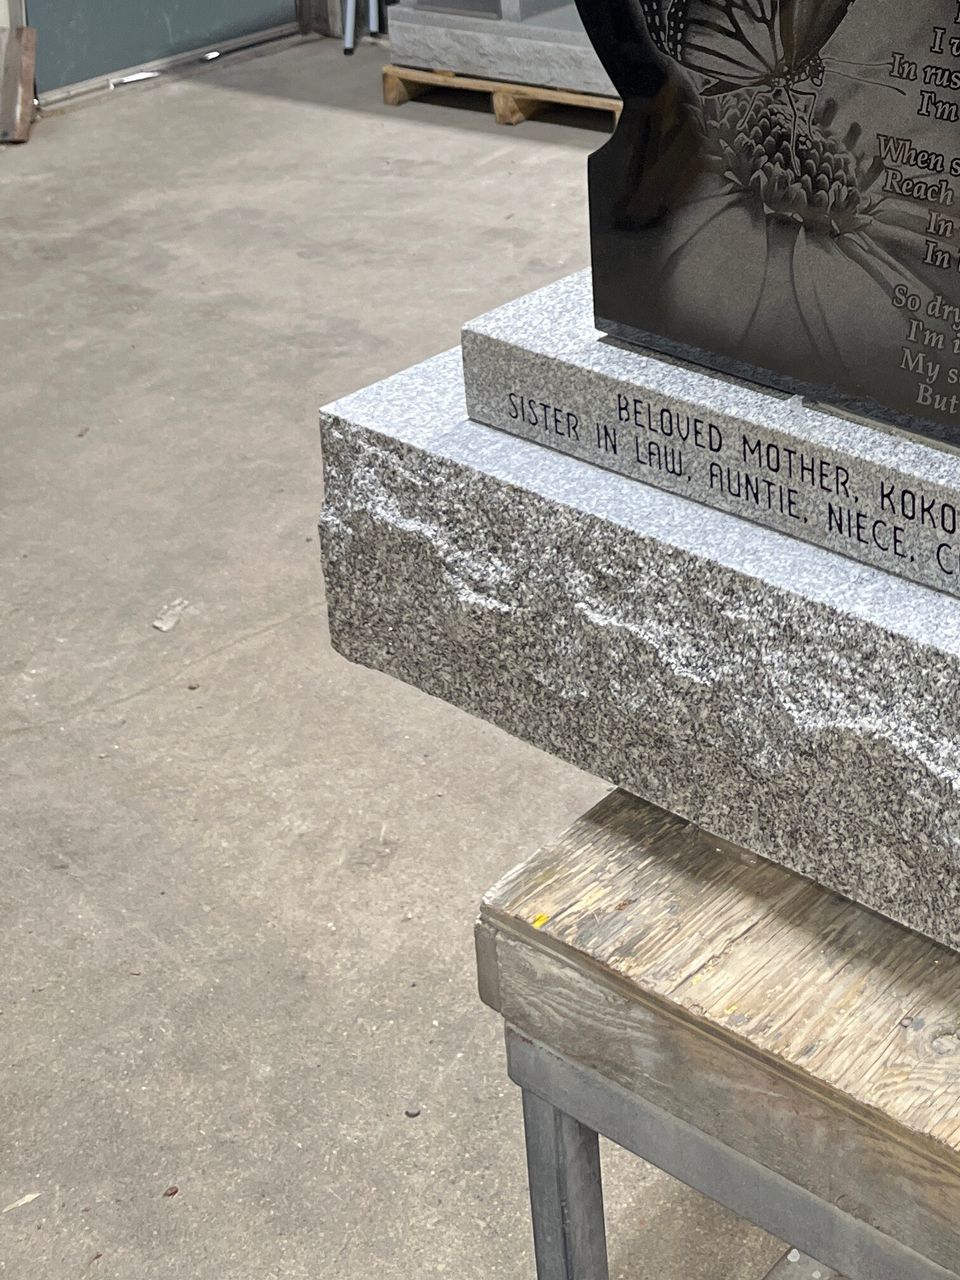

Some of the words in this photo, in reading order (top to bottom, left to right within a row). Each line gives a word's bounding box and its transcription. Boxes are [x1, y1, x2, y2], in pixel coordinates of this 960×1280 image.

[932, 28, 945, 52] I
[890, 53, 917, 80] In
[918, 90, 958, 121] I'm
[877, 133, 945, 172] When
[884, 168, 954, 206] Reach
[926, 211, 953, 238] In
[924, 240, 951, 269] In
[892, 284, 921, 312] So
[907, 318, 945, 350] I'm
[901, 347, 941, 384] My
[916, 383, 960, 414] But
[617, 393, 722, 453] BELOVED
[742, 435, 859, 503] MOTHER,
[508, 393, 580, 441] SISTER
[596, 422, 617, 455] IN
[635, 437, 692, 483] LAW,
[709, 462, 808, 524] AUNTIE,
[827, 503, 915, 563] NIECE,
